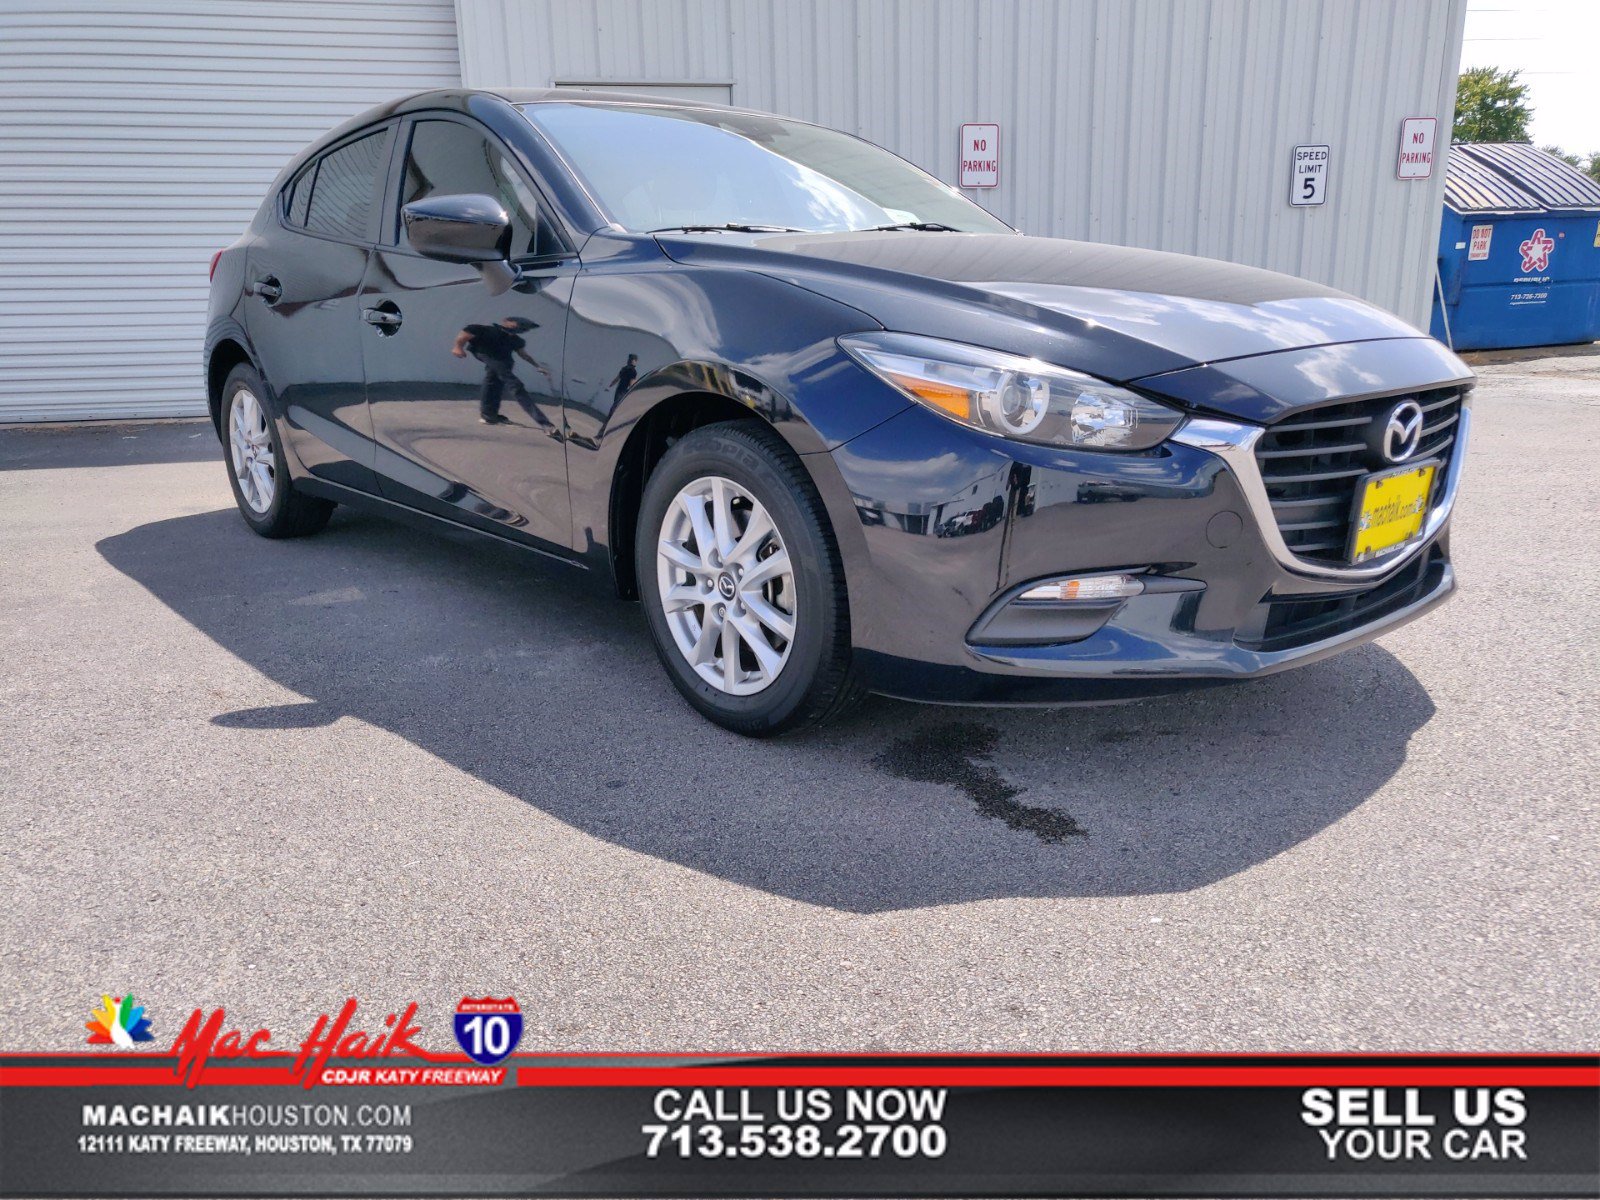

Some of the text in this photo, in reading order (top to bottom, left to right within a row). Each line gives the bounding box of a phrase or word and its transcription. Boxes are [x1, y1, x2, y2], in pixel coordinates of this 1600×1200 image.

[1412, 132, 1425, 144] NO
[973, 139, 987, 151] NO
[1297, 151, 1327, 160] SPEED
[1401, 152, 1431, 163] PARKING
[963, 160, 996, 172] PARKING
[1298, 164, 1323, 173] LIMIT
[1302, 177, 1315, 199] 5
[1473, 228, 1492, 239] DO NOT
[1473, 241, 1488, 251] PARK
